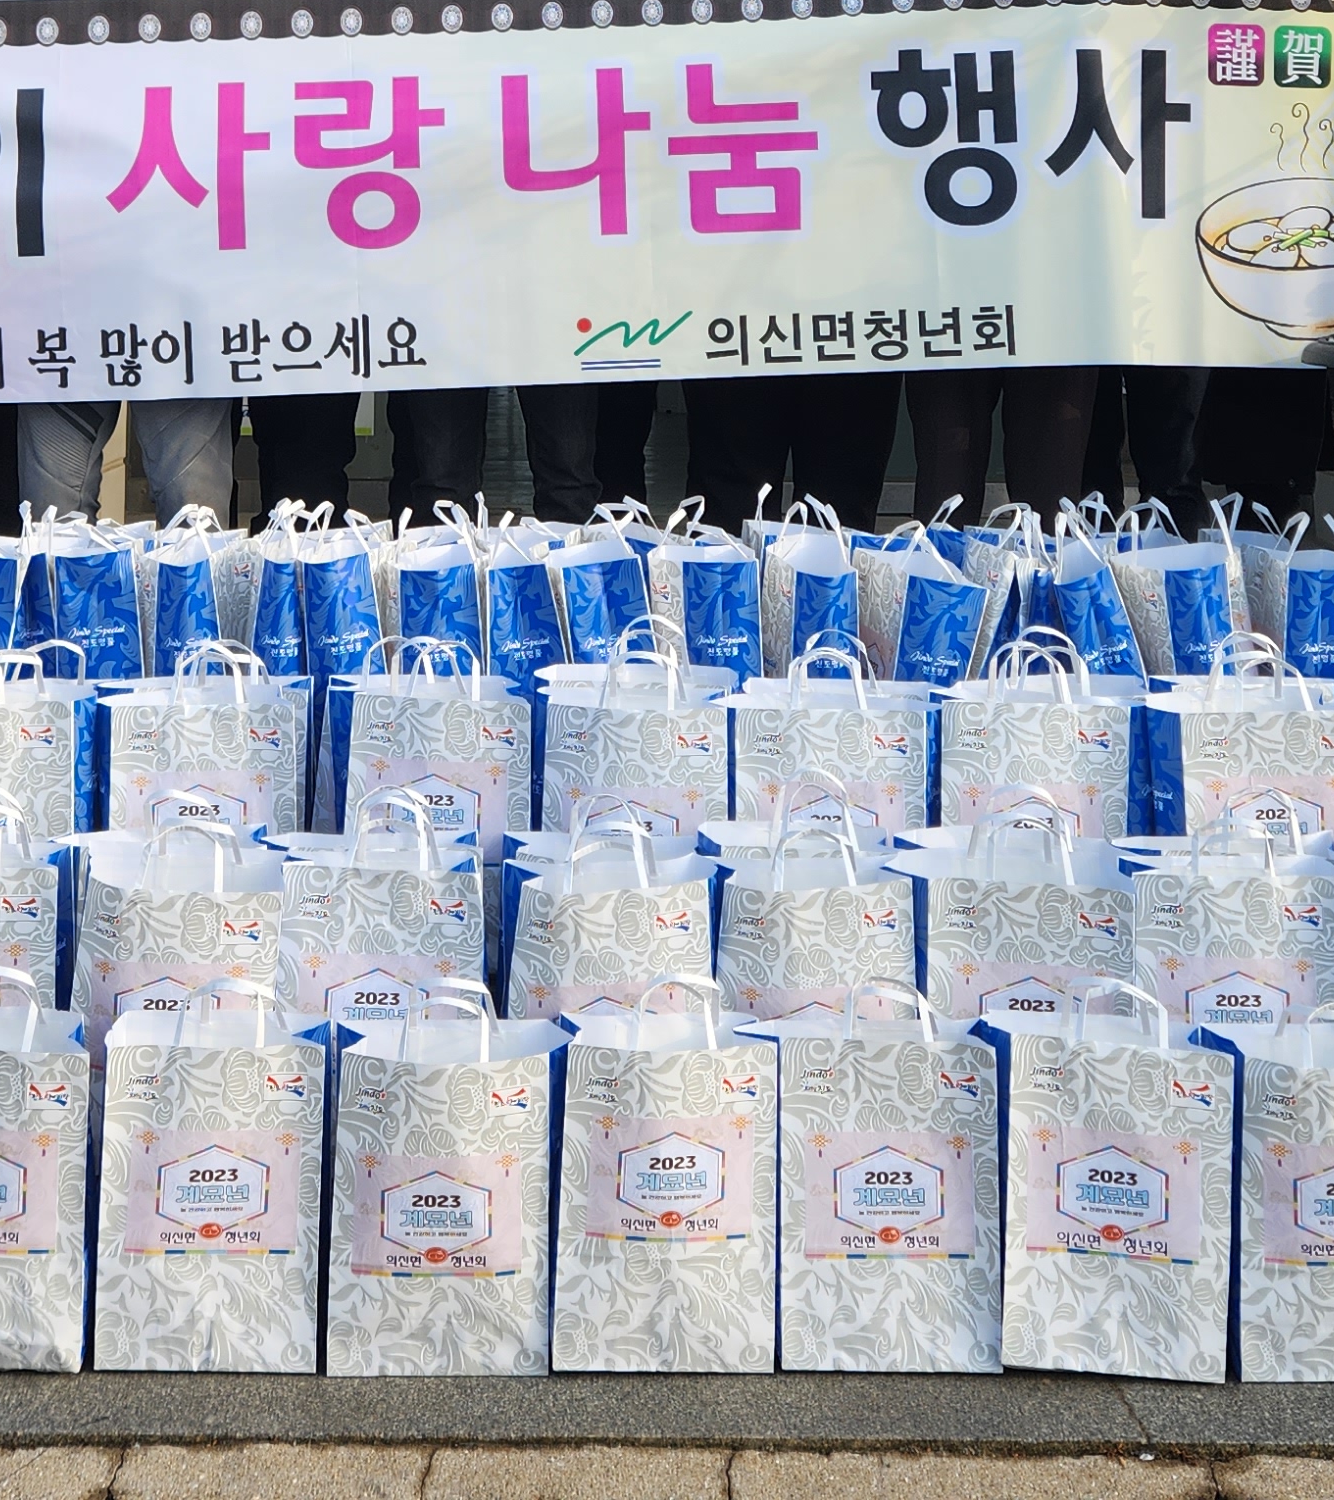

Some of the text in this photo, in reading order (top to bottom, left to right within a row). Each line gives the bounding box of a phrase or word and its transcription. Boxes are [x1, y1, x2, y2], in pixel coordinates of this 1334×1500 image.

[106, 77, 445, 251] 사랑
[501, 63, 820, 236] 나눔
[870, 48, 1192, 227] 행사
[703, 301, 1019, 367] 의신면청년회
[27, 326, 78, 389] 복
[99, 321, 195, 388] 많이
[219, 316, 428, 386] 받으세요
[353, 991, 401, 1006] 2023
[1008, 997, 1056, 1013] 2023
[1215, 994, 1262, 1008] 2023
[800, 1069, 828, 1079] Jindo
[1030, 1067, 1058, 1077] Jindo
[126, 1076, 154, 1086] Jindo
[585, 1077, 613, 1088] Jindo
[355, 1087, 381, 1099] Jindo
[1262, 1094, 1291, 1107] Jindo
[649, 1156, 696, 1171] 2023
[189, 1169, 239, 1182] 2023
[636, 1171, 707, 1192] 계묘년
[865, 1171, 913, 1185] 2023
[1088, 1168, 1138, 1186] 2023
[176, 1184, 250, 1203] 계묘년
[412, 1194, 461, 1208] 2023
[853, 1187, 925, 1206] 계묘년
[1076, 1184, 1150, 1209] 계묘년
[399, 1210, 474, 1228] 계묘년
[1057, 1232, 1168, 1256] 의신면 청년회
